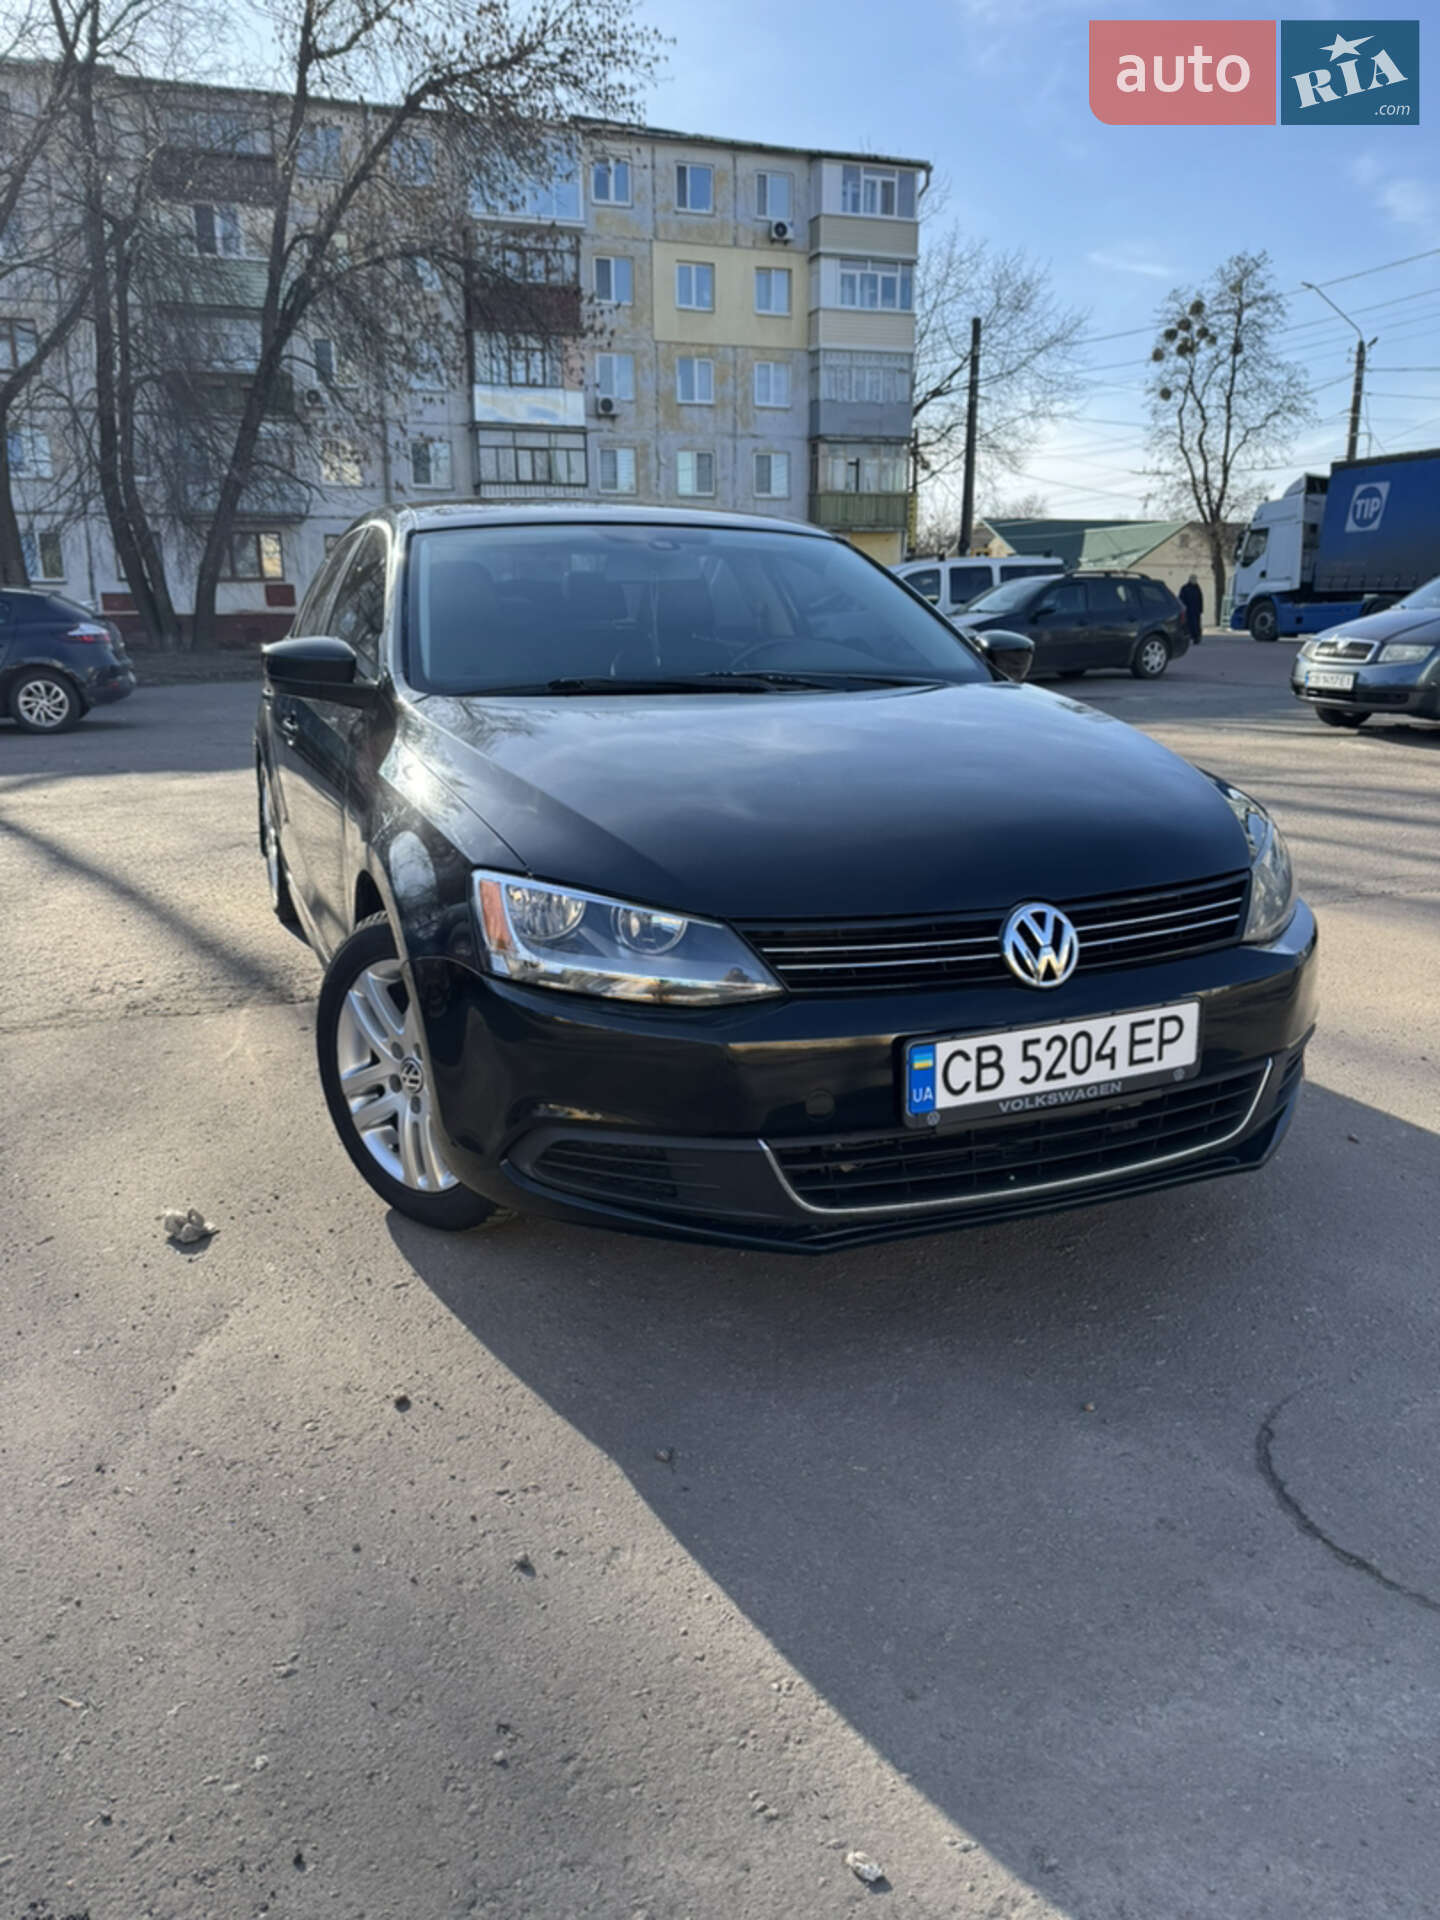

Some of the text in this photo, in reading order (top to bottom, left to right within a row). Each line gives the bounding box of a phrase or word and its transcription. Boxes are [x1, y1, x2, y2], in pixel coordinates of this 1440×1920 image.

[1355, 497, 1381, 519] TIP
[942, 1015, 1185, 1096] CB 5204 EP
[912, 1086, 934, 1103] UA
[999, 1081, 1123, 1113] VOLKSWAGEN
